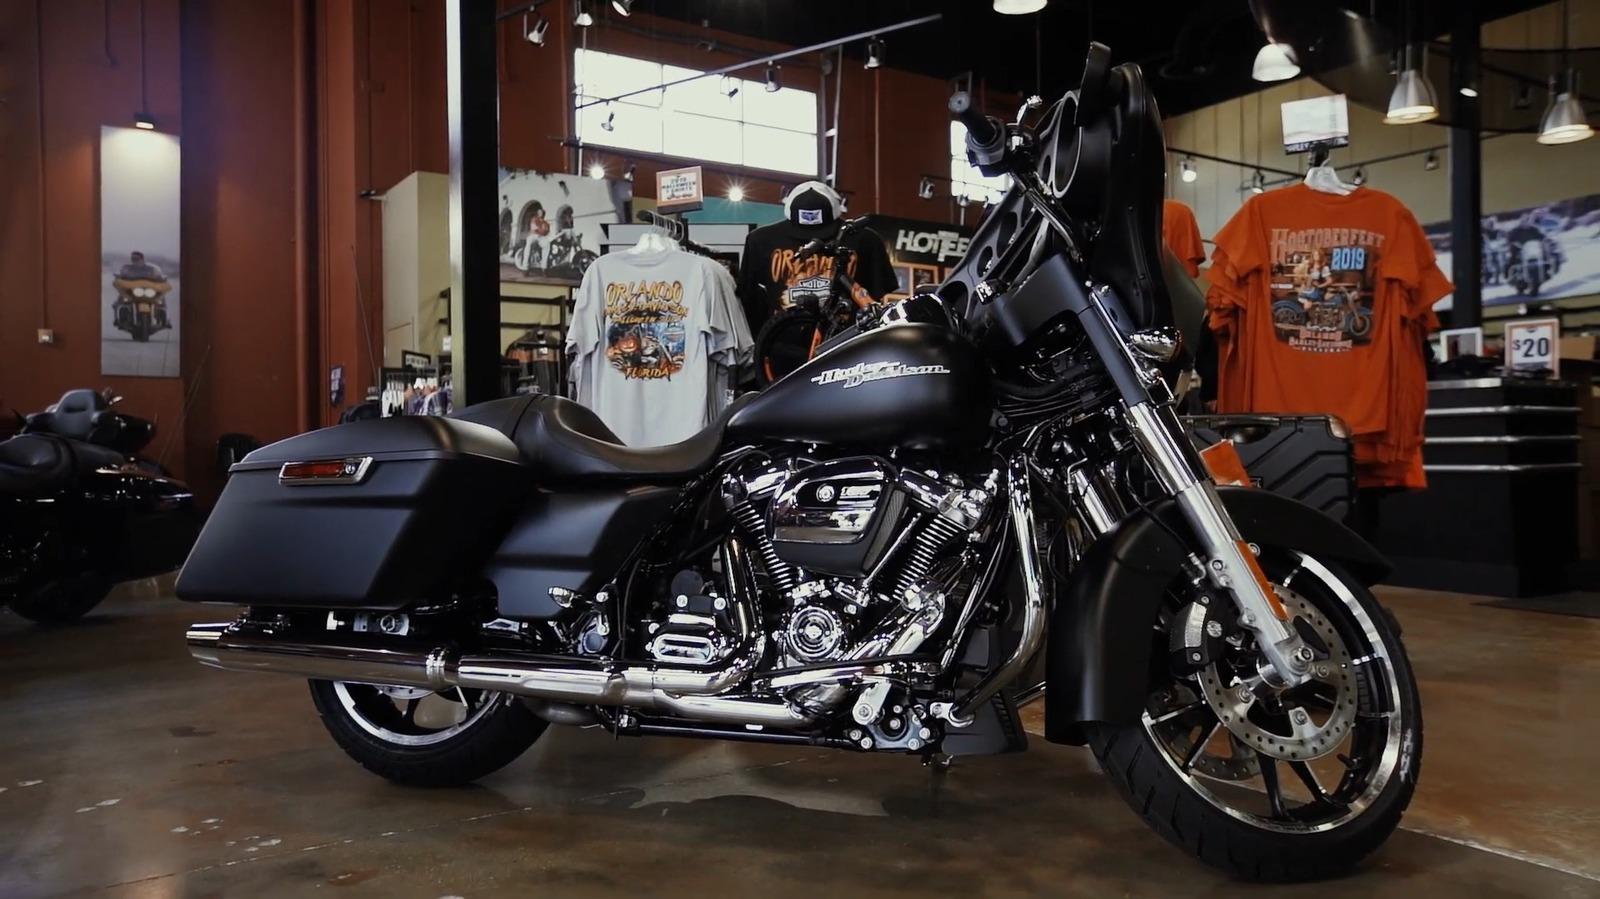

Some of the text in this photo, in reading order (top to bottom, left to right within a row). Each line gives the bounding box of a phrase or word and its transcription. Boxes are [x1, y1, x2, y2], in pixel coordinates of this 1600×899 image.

[1331, 247, 1366, 271] 2019
[605, 280, 685, 306] ORLANDO
[1512, 337, 1549, 358] $20
[625, 366, 670, 379] FLORIDA
